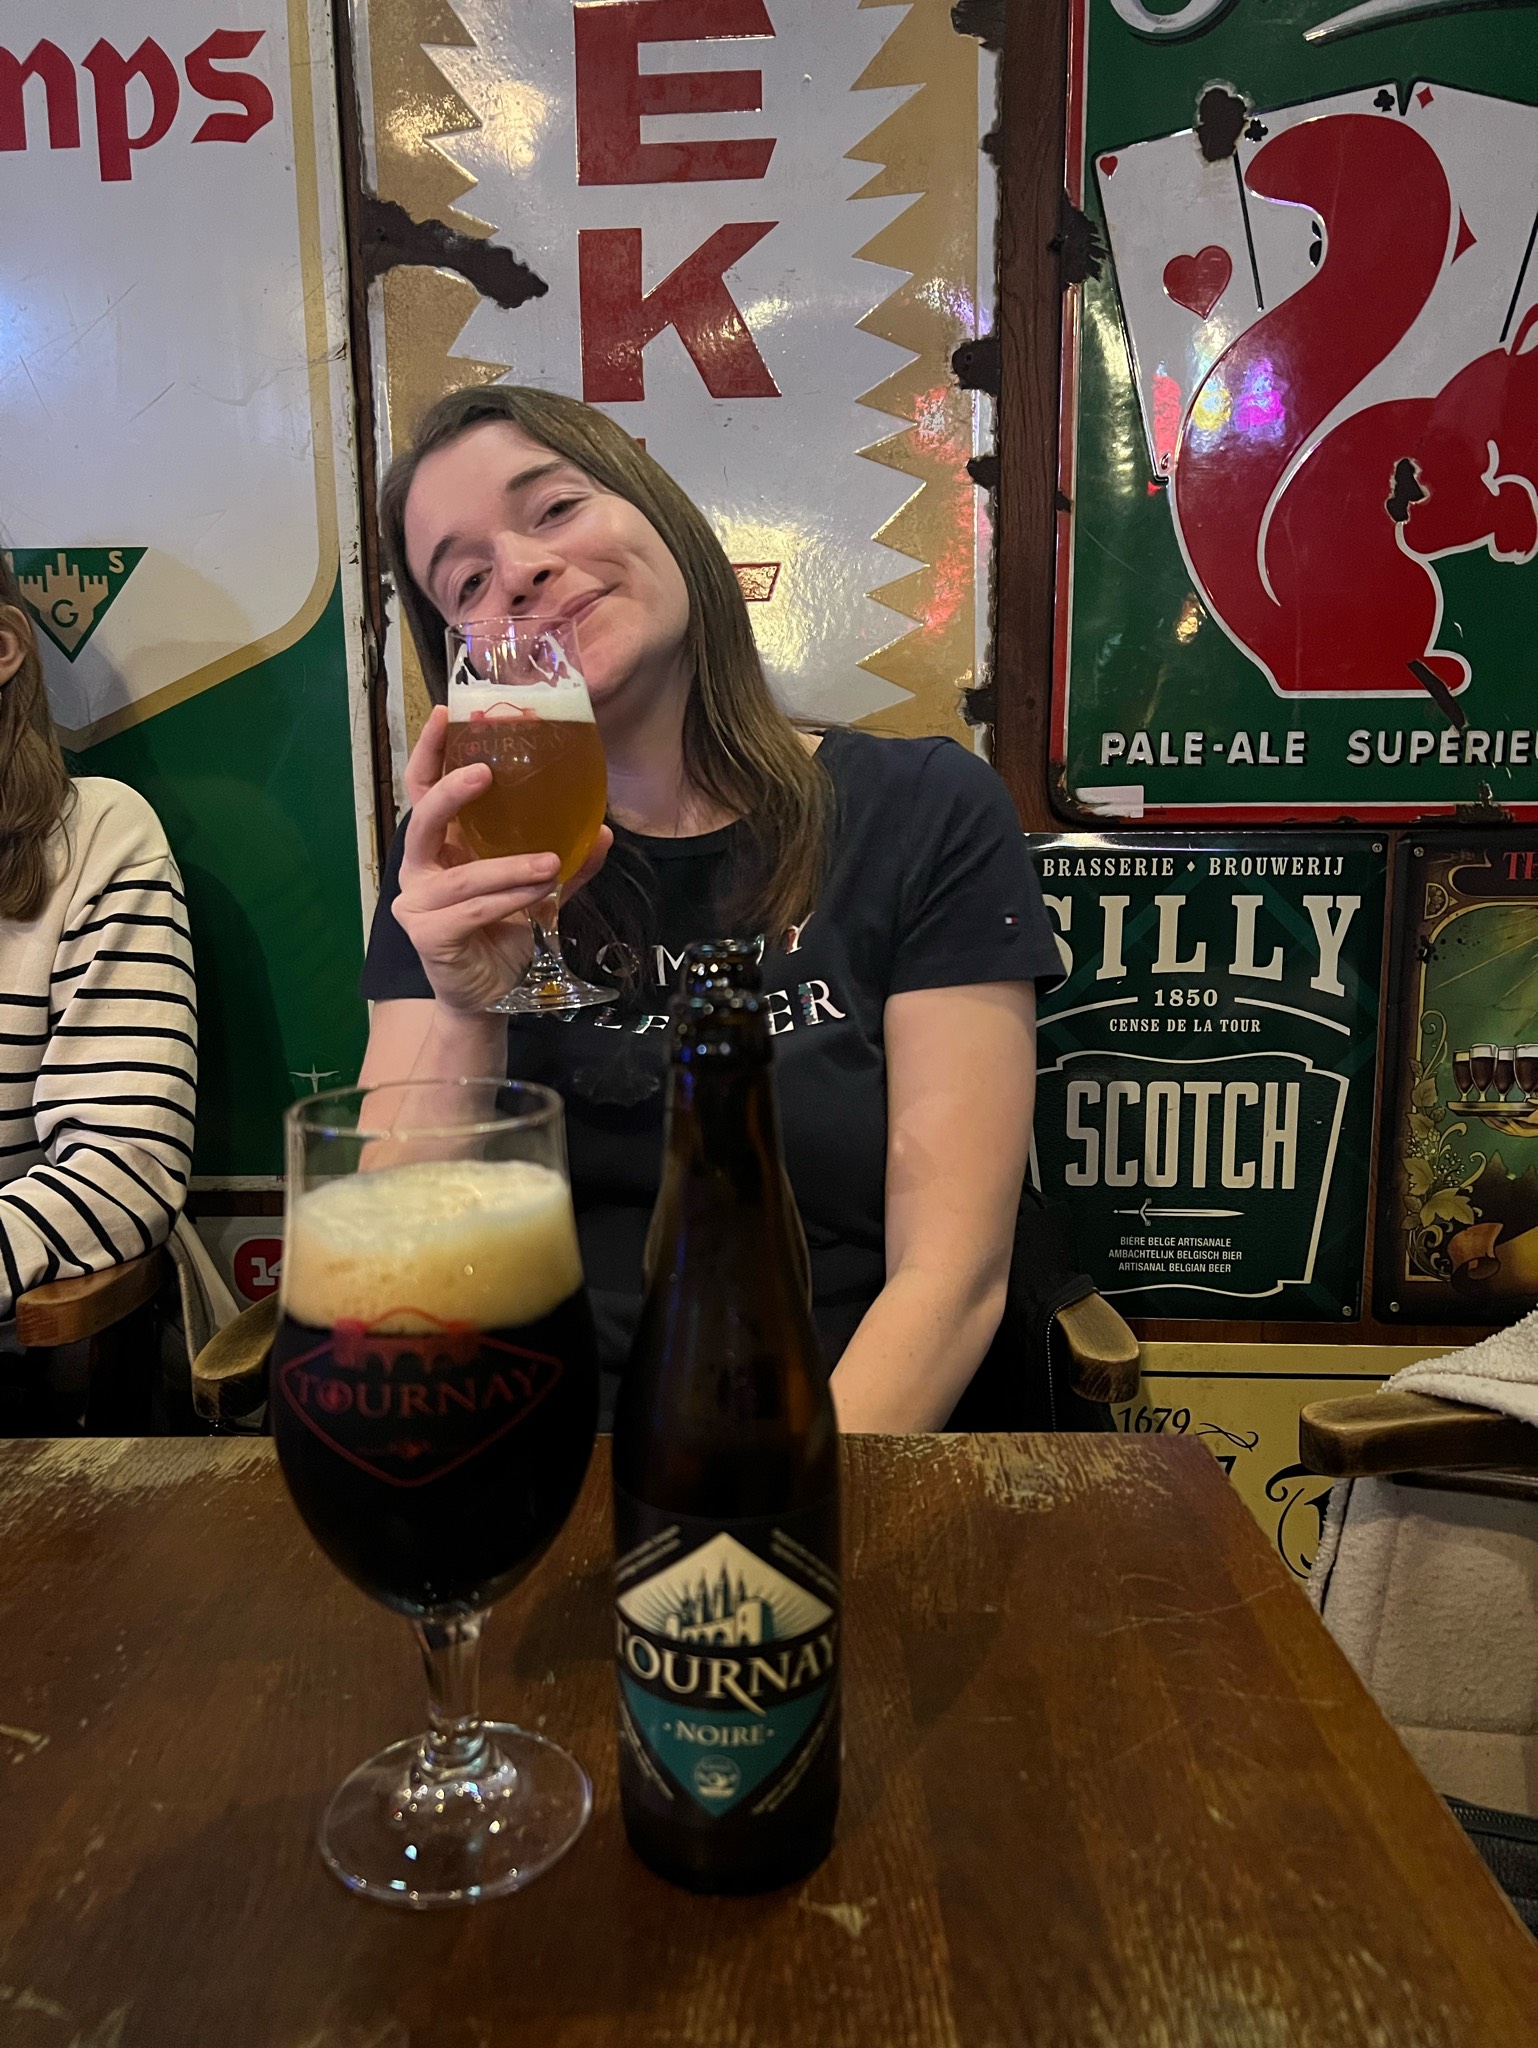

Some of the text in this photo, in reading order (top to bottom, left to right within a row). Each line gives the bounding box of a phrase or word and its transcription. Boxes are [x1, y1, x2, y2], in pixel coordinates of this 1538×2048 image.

[51, 599, 79, 628] G
[1101, 724, 1538, 766] PALE-ALE SUPÉRIE
[1042, 856, 1345, 877] BRASSERIE BROUWERIJ
[1154, 988, 1218, 1007] 1850
[1109, 1018, 1261, 1033] CENSE DE LA TOUR
[1065, 1080, 1300, 1190] SCOTCH
[1147, 1236, 1176, 1247] BELGE
[1177, 1237, 1232, 1248] ARTISANALE
[1108, 1249, 1243, 1261] AMBACHTELIJK BELGISCH BIER
[1118, 1262, 1232, 1274] ARTISANAL BELGIAN BEER
[288, 1362, 539, 1418] TOURNAY
[1118, 1406, 1191, 1435] 1679
